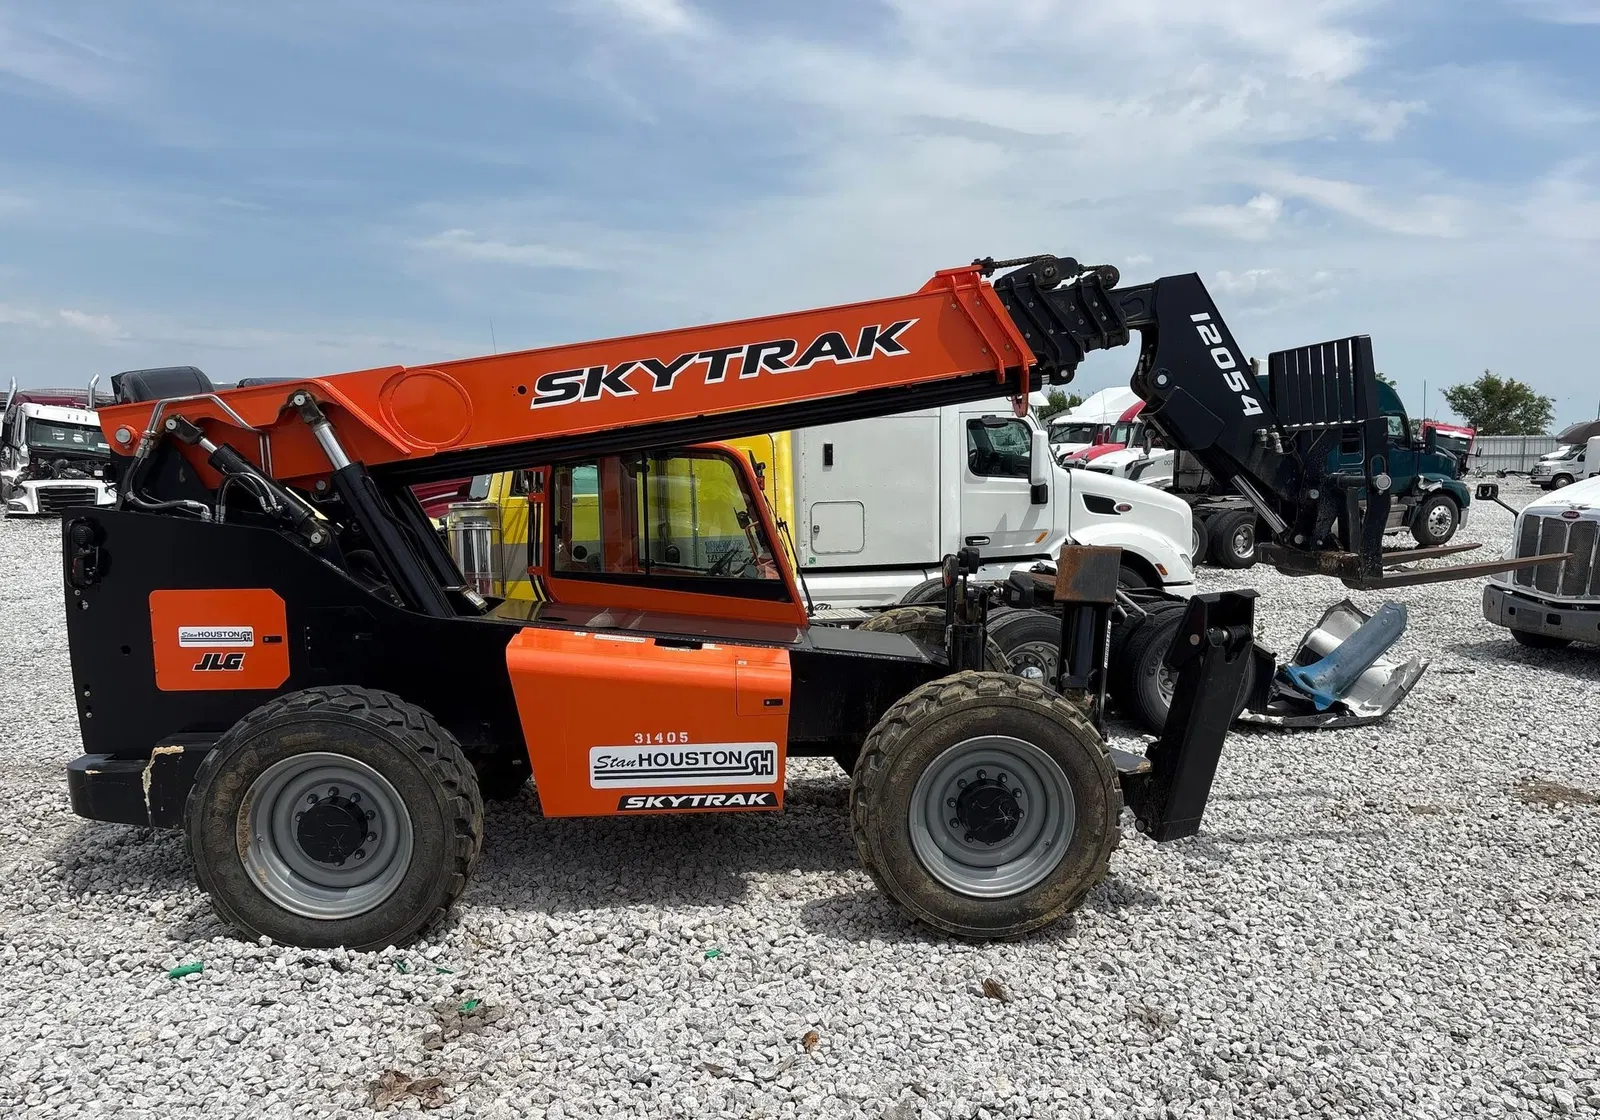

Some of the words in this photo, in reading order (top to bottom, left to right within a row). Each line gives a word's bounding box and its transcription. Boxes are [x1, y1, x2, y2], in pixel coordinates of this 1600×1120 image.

[530, 318, 920, 410] SKYTRAK
[1189, 312, 1264, 417] 12054
[192, 652, 246, 671] JLG
[634, 731, 689, 744] 31405
[594, 755, 636, 769] Stan
[638, 750, 742, 767] HOUSTON
[625, 793, 770, 809] SKYTRAK
